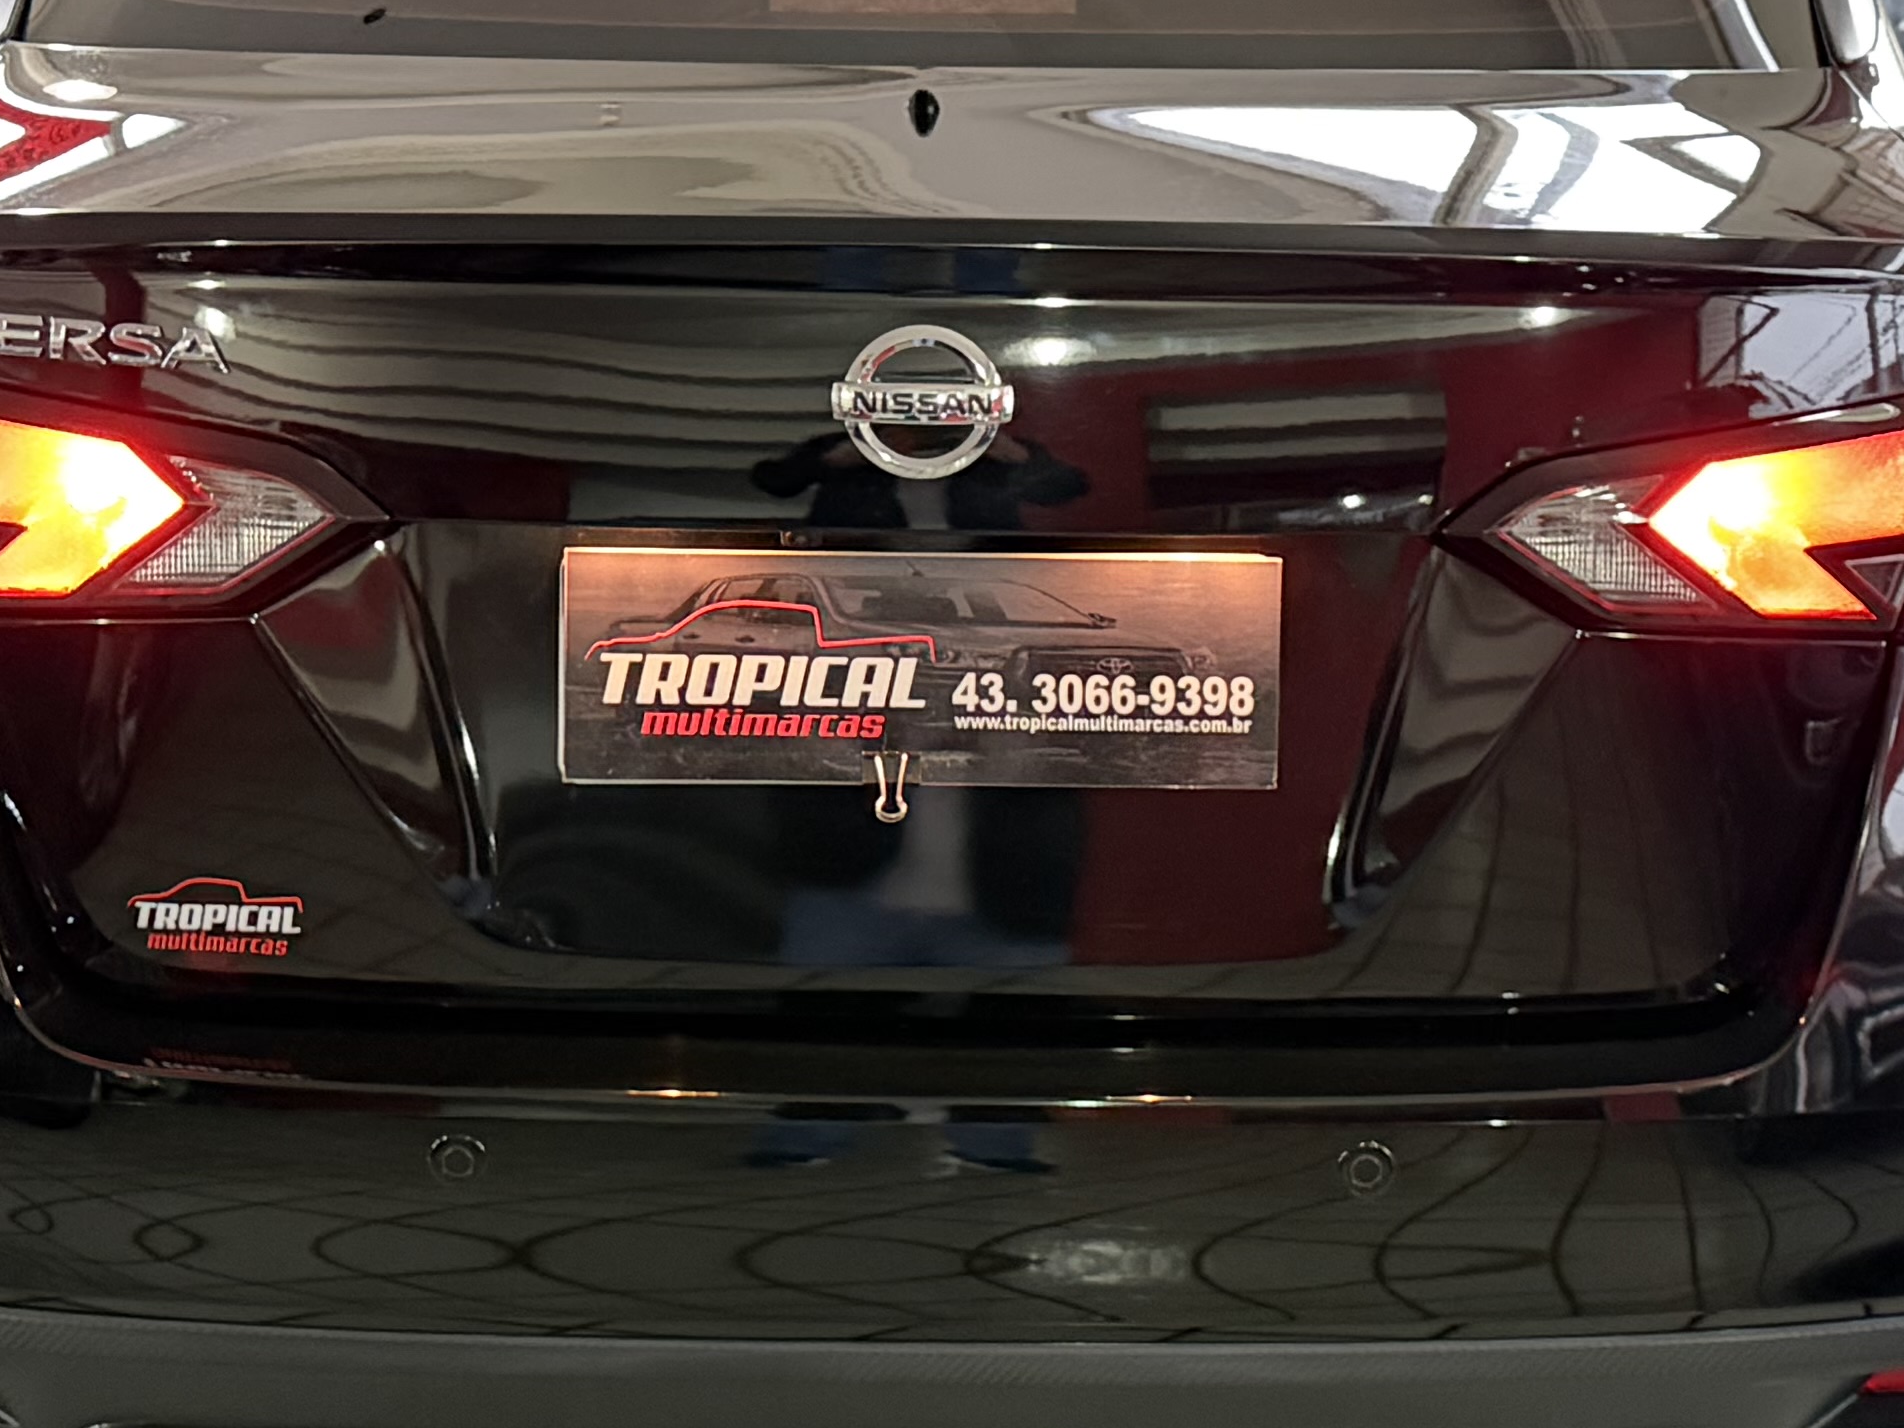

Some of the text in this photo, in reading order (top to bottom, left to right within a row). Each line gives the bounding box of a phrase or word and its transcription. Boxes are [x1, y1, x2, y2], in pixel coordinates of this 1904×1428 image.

[852, 391, 993, 416] NISSAN
[599, 652, 926, 710] TROPICAL
[1031, 673, 1255, 717] 3066-9398
[640, 708, 886, 740] multimarcas
[953, 713, 1253, 735] www.tropicalmultimarcas.com.br
[134, 900, 302, 935] TROPICAL
[147, 930, 289, 957] multimarcas
